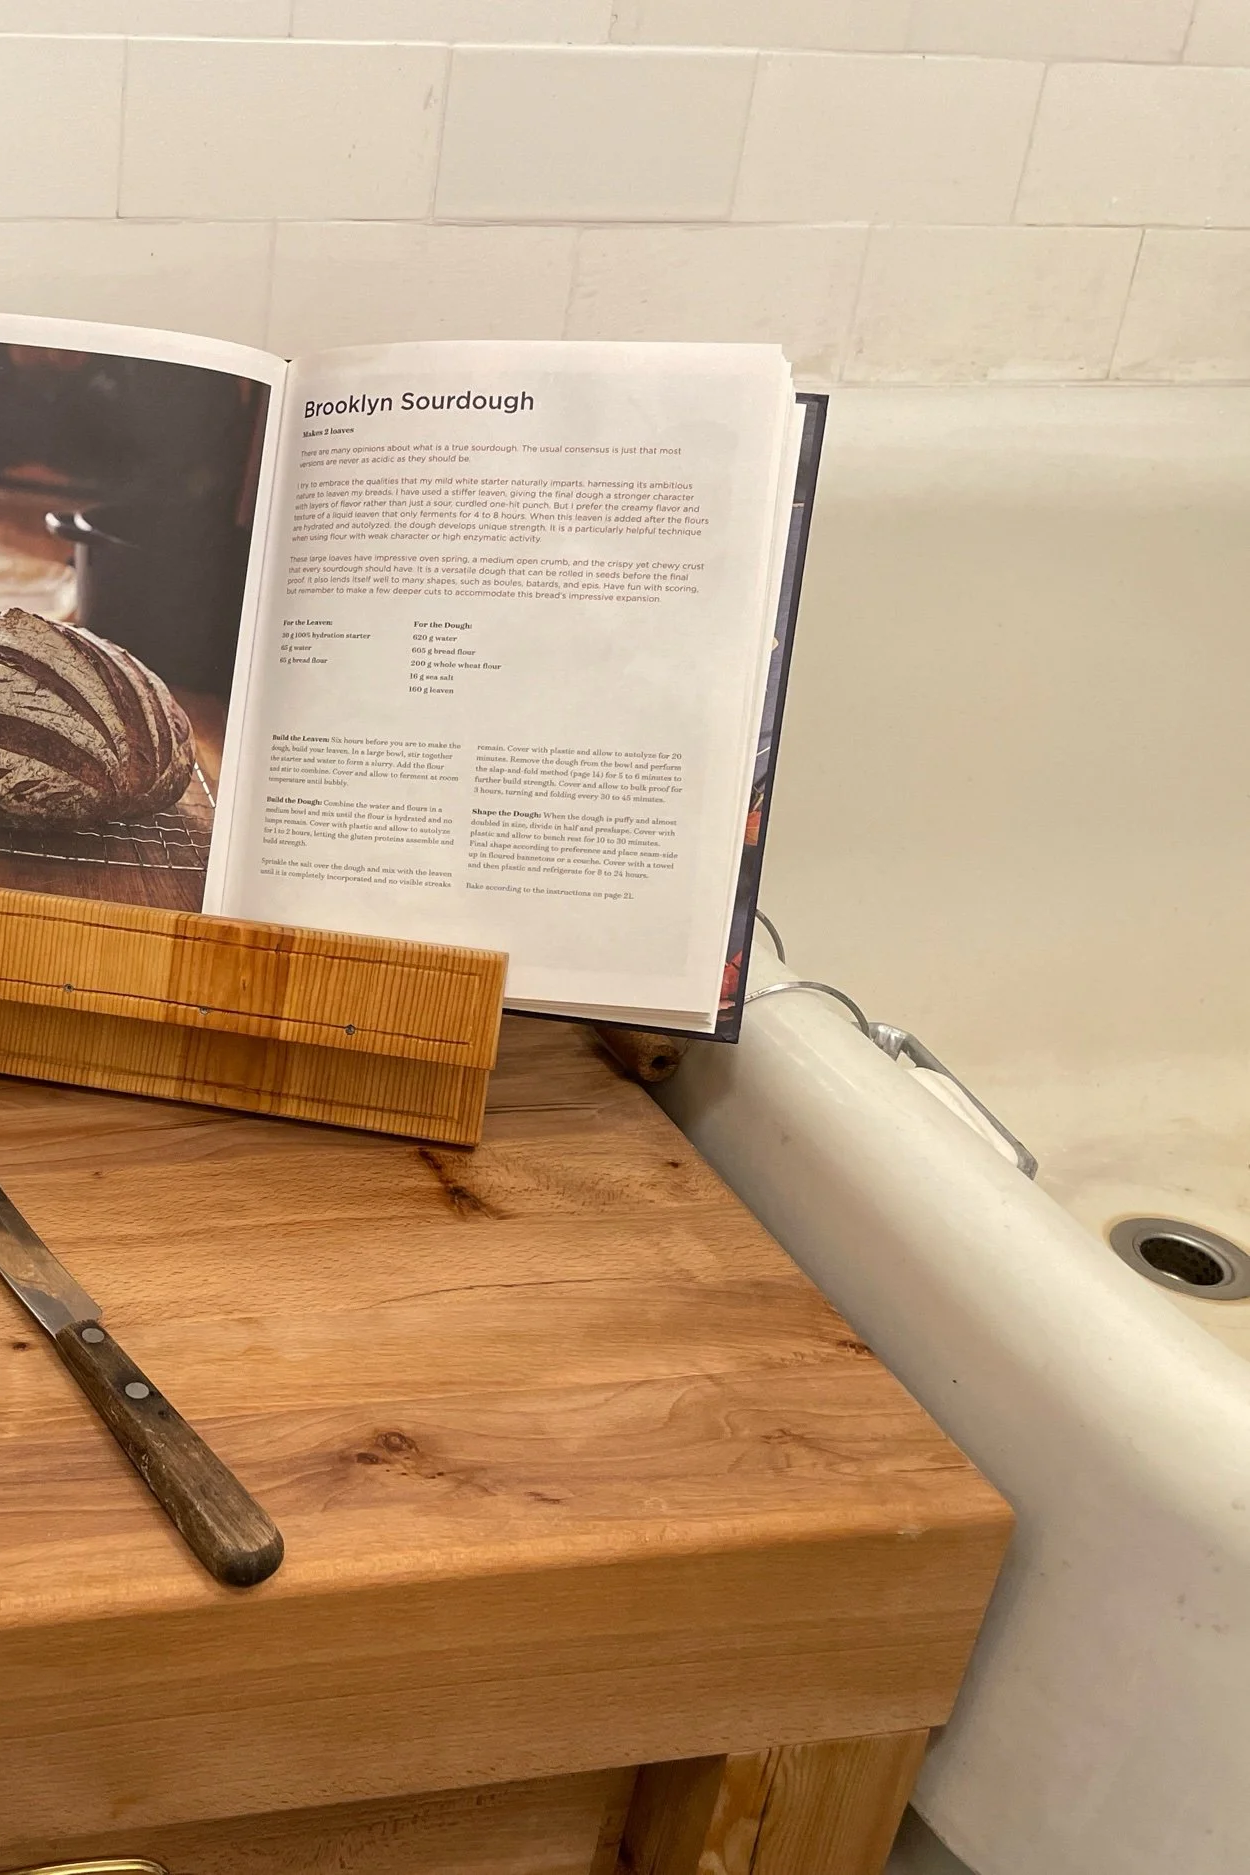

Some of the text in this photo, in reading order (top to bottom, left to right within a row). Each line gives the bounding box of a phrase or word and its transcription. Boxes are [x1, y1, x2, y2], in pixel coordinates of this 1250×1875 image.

[304, 391, 534, 418] Brooklyn Sourdough
[302, 430, 323, 438] Makes
[330, 427, 354, 435] loaves
[301, 450, 318, 458] There
[330, 447, 351, 455] many
[351, 446, 386, 454] opinions
[386, 444, 411, 452] about
[435, 444, 442, 452] is
[451, 444, 469, 452] true
[522, 444, 538, 453] The
[539, 445, 563, 453] usual
[564, 446, 610, 454] consensus
[620, 447, 637, 456] just
[639, 447, 657, 455] that
[659, 447, 681, 455] most
[371, 455, 395, 464] acidic
[408, 455, 427, 464] they
[428, 454, 457, 463] should
[300, 482, 309, 490] try
[310, 480, 318, 488] to
[318, 480, 350, 488] embrace
[351, 478, 365, 486] the
[365, 477, 399, 487] qualities
[401, 477, 418, 485] that
[419, 478, 433, 486] my
[434, 477, 454, 485] mild
[455, 477, 479, 485] white
[480, 478, 509, 486] starter
[510, 479, 549, 489] naturally
[587, 480, 635, 490] harnessing
[636, 481, 647, 489] its
[649, 481, 693, 490] ambitious
[309, 555, 327, 564] large
[328, 554, 353, 562] loaves
[353, 554, 373, 562] have
[374, 554, 418, 564] impressive
[479, 556, 515, 564] medium
[516, 558, 539, 566] open
[572, 559, 589, 567] and
[591, 559, 605, 568] the
[607, 560, 634, 570] crispy
[635, 561, 650, 572] yet
[651, 561, 681, 571] chewy
[444, 622, 472, 630] Dough:
[311, 631, 345, 640] hydration
[433, 647, 456, 655] bread
[457, 648, 476, 656] flour
[292, 656, 311, 664] bread
[311, 656, 328, 664] flour
[433, 660, 457, 668] whole
[482, 662, 502, 670] flour
[410, 672, 418, 680] 16
[429, 686, 454, 694] leaven
[290, 734, 302, 742] the
[302, 735, 330, 743] Leaven:
[330, 736, 343, 744] Six
[343, 736, 364, 745] hours
[365, 738, 389, 746] before
[427, 741, 448, 749] make
[506, 744, 530, 753] Cover
[531, 746, 549, 754] with
[549, 747, 575, 757] plastic
[576, 748, 591, 756] and
[592, 748, 613, 757] allow
[624, 751, 657, 761] autolyze
[658, 752, 671, 760] for
[671, 752, 682, 760] 20
[297, 798, 323, 806] Dough:
[323, 799, 355, 808] Combine
[355, 801, 368, 809] the
[406, 804, 428, 812] flours
[472, 808, 677, 826] Shape the Dough: When the dough is puffy and almost
[485, 884, 522, 894] according
[532, 886, 545, 894] the
[546, 887, 591, 897] instructions
[604, 892, 622, 900] page
